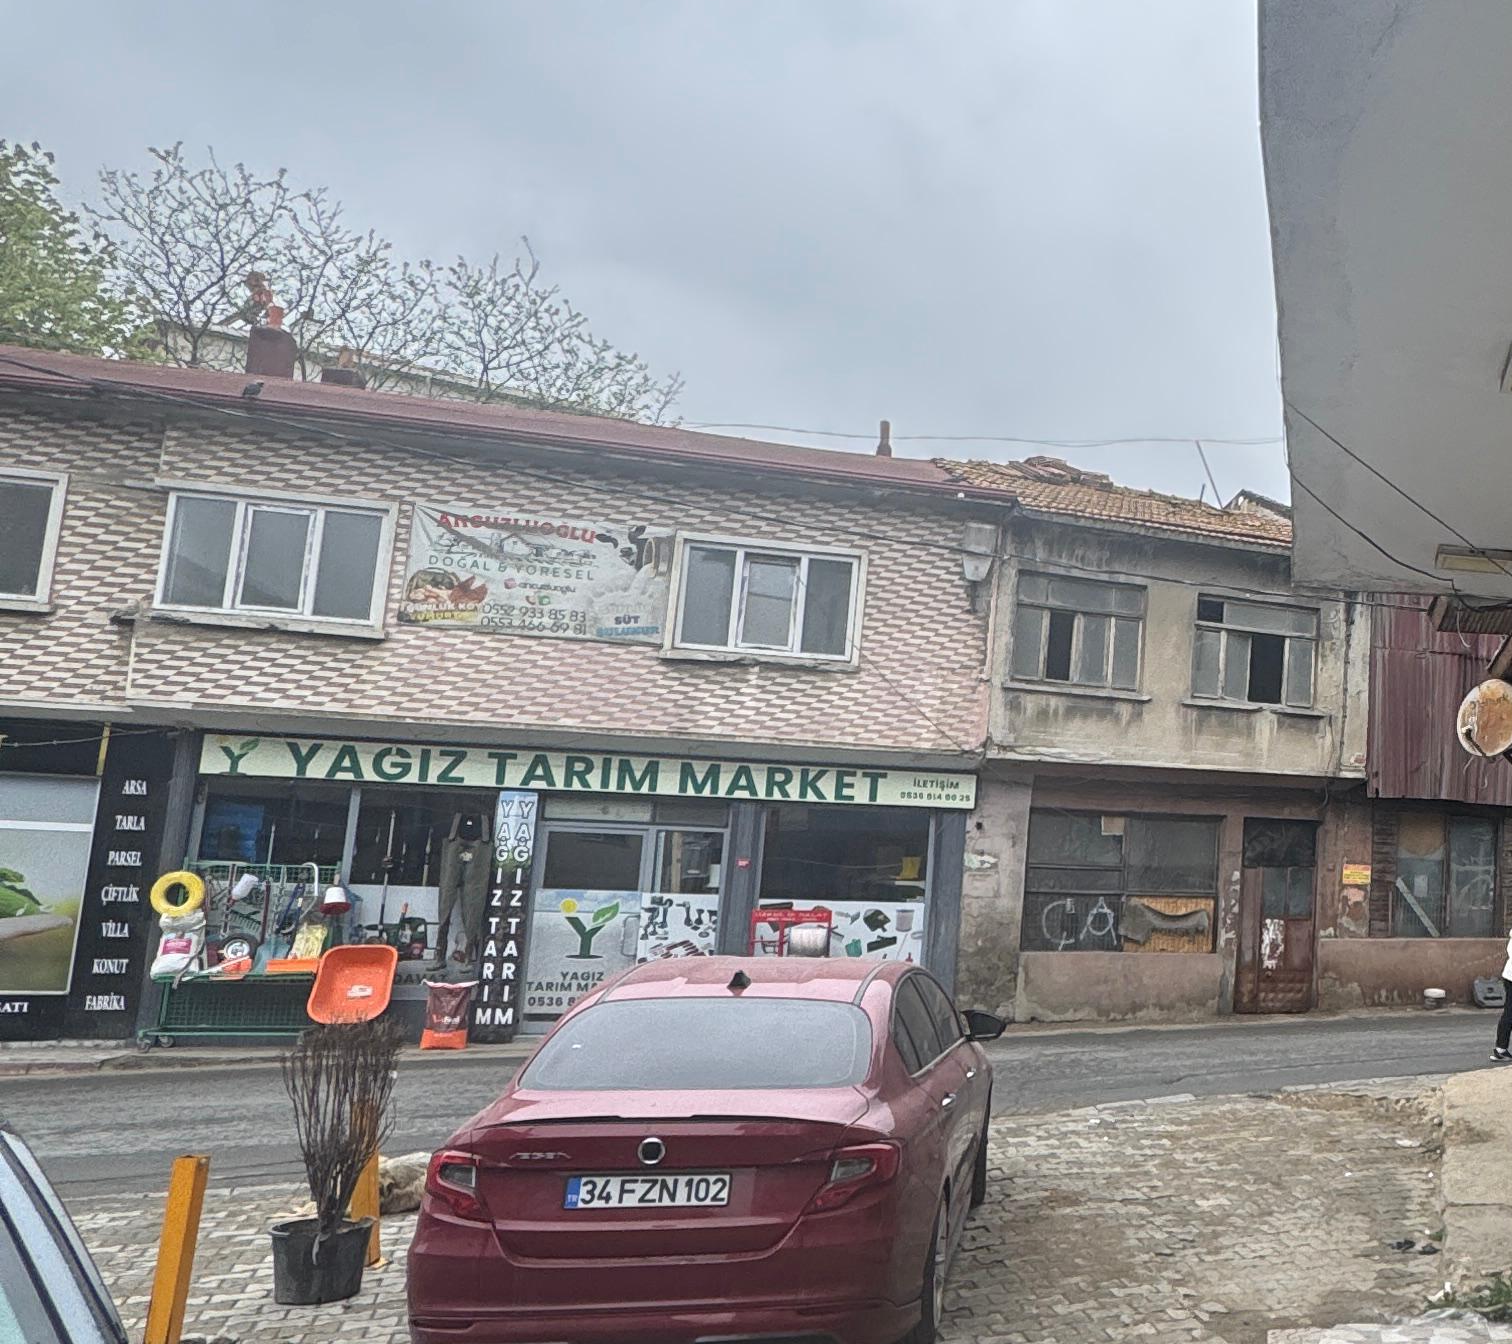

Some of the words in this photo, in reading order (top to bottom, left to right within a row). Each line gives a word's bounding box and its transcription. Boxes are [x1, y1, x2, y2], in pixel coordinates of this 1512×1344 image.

[428, 555, 491, 572] DOĞAL
[482, 604, 514, 617] 0552
[519, 606, 545, 619] 933
[549, 608, 567, 621] 85
[569, 610, 587, 622] 83
[480, 615, 513, 627] 0553
[518, 618, 546, 632] 466
[487, 751, 660, 793] TARIM
[677, 760, 888, 804] MARKET
[121, 779, 148, 796] ARSA
[114, 815, 146, 832] TARLA
[106, 850, 142, 867] PARSEL
[100, 882, 140, 906] ÇİFTLİK
[101, 918, 130, 938] VİLLA
[91, 958, 129, 975] KONUT
[475, 917, 500, 1025] TARIM
[494, 917, 521, 1025] TARIM
[526, 981, 573, 992] TARIM
[0, 1001, 30, 1013] ATI
[84, 990, 126, 1011] FABRİKA
[527, 996, 563, 1007] 0536
[580, 1178, 613, 1205] 34
[617, 1177, 679, 1205] FZN
[684, 1176, 728, 1203] 102
